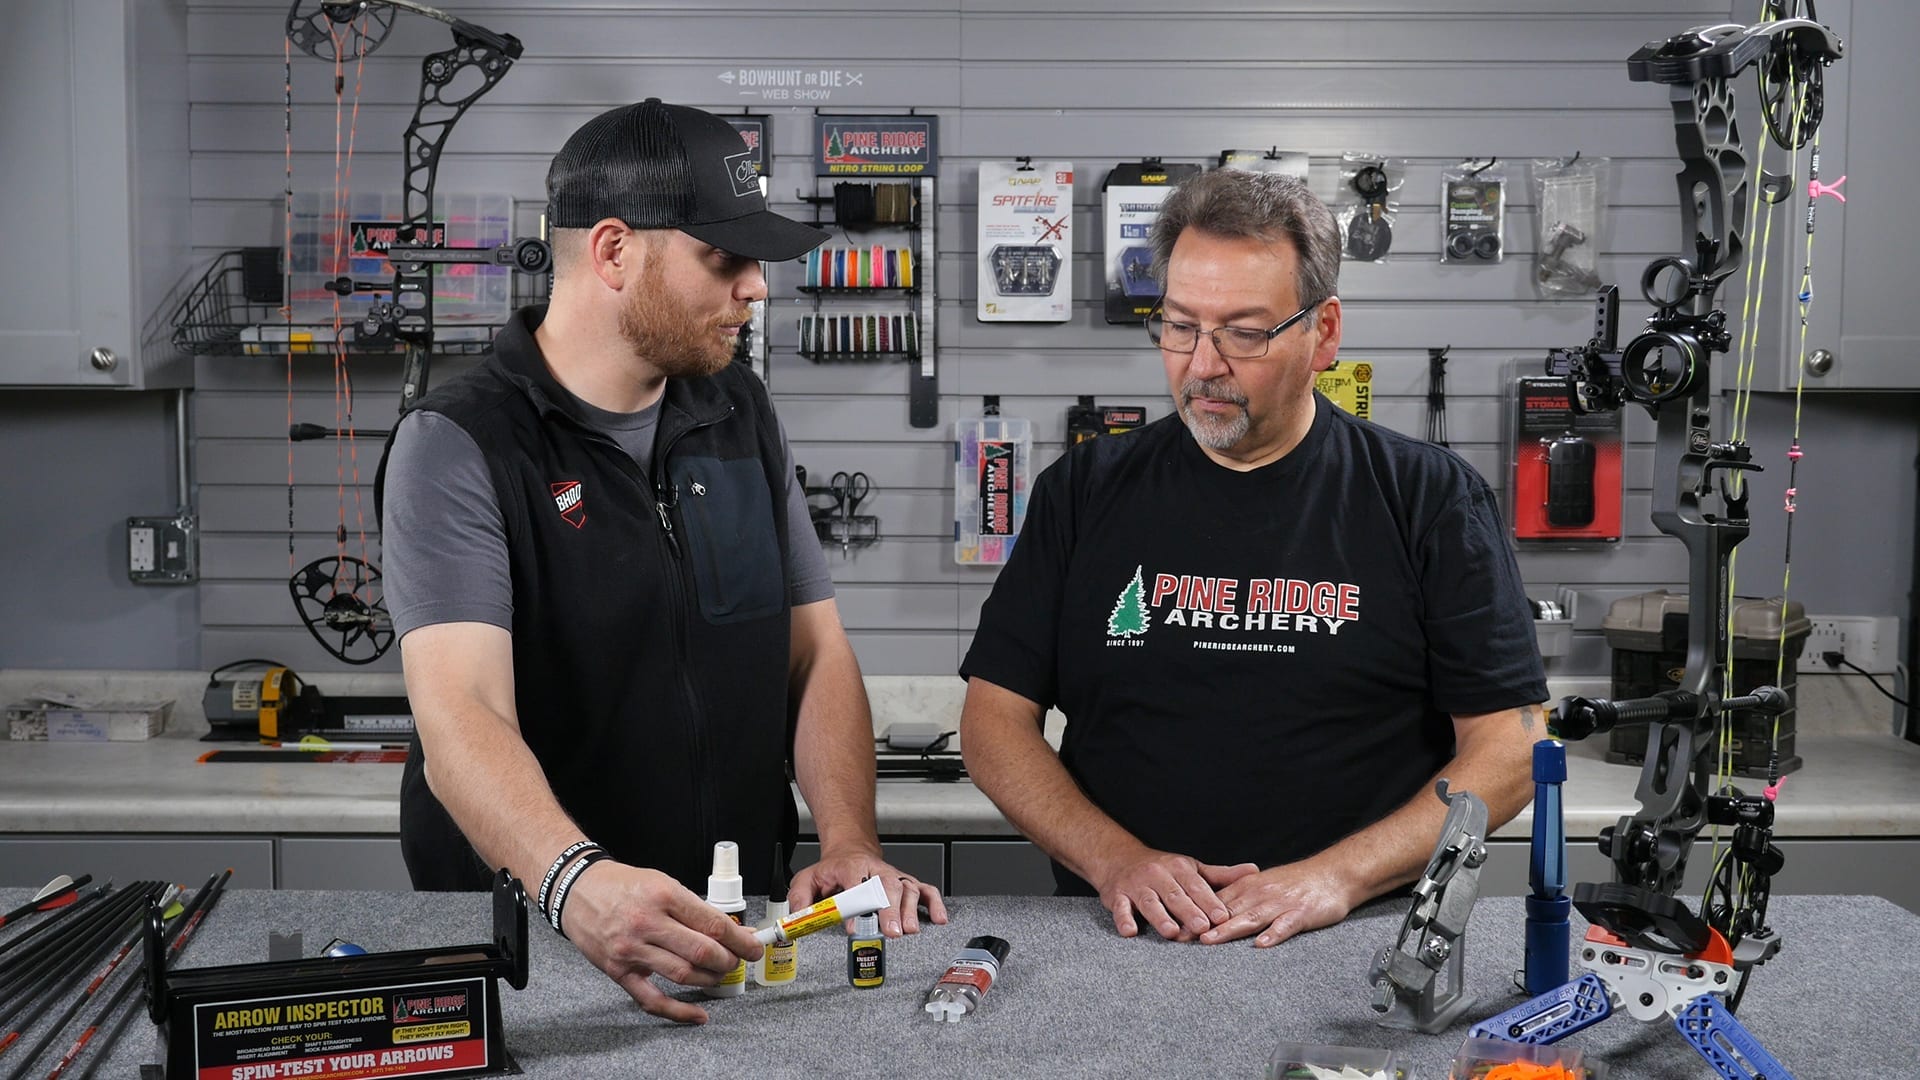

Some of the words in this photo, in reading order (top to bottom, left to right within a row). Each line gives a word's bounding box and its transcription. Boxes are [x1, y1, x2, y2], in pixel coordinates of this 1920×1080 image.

[739, 69, 802, 87] BOWHUNT
[804, 73, 818, 85] OR
[820, 70, 842, 87] DIE
[762, 88, 790, 100] WEB
[793, 88, 831, 100] SHOW
[843, 131, 878, 148] PINE
[881, 131, 926, 148] RIDGE
[849, 146, 921, 155] ARCHERY
[829, 164, 859, 173] NITRO
[861, 164, 895, 173] STRING
[897, 164, 924, 173] LOOP
[992, 190, 1058, 207] SPITFIRE
[1314, 377, 1351, 387] USTOM
[1355, 385, 1369, 420] STRU
[994, 458, 1008, 490] PINE
[987, 464, 995, 528] ARCHERY
[994, 493, 1008, 534] RIDGE
[1151, 573, 1239, 614] PINE
[1247, 577, 1360, 621] RIDGE
[1164, 609, 1345, 635] ARCHERY
[1193, 641, 1296, 653] PINERIDGEARCHERY.COM
[539, 856, 565, 911] ARCHERY
[406, 998, 432, 1011] PINE
[411, 1005, 463, 1016] ARCHERY
[1488, 1016, 1509, 1031] PINE
[1511, 1004, 1538, 1021] RIDGE
[1538, 985, 1578, 1008] ARCHERY
[214, 1006, 282, 1031] ARROW
[286, 997, 385, 1023] INSPECTOR
[271, 1035, 303, 1046] CHECK
[305, 1032, 333, 1042] YOUR:
[434, 1030, 445, 1038] FLY
[232, 1058, 325, 1080] SPIN-TEST
[329, 1053, 376, 1072] YOUR
[380, 1045, 454, 1066] ARROWS
